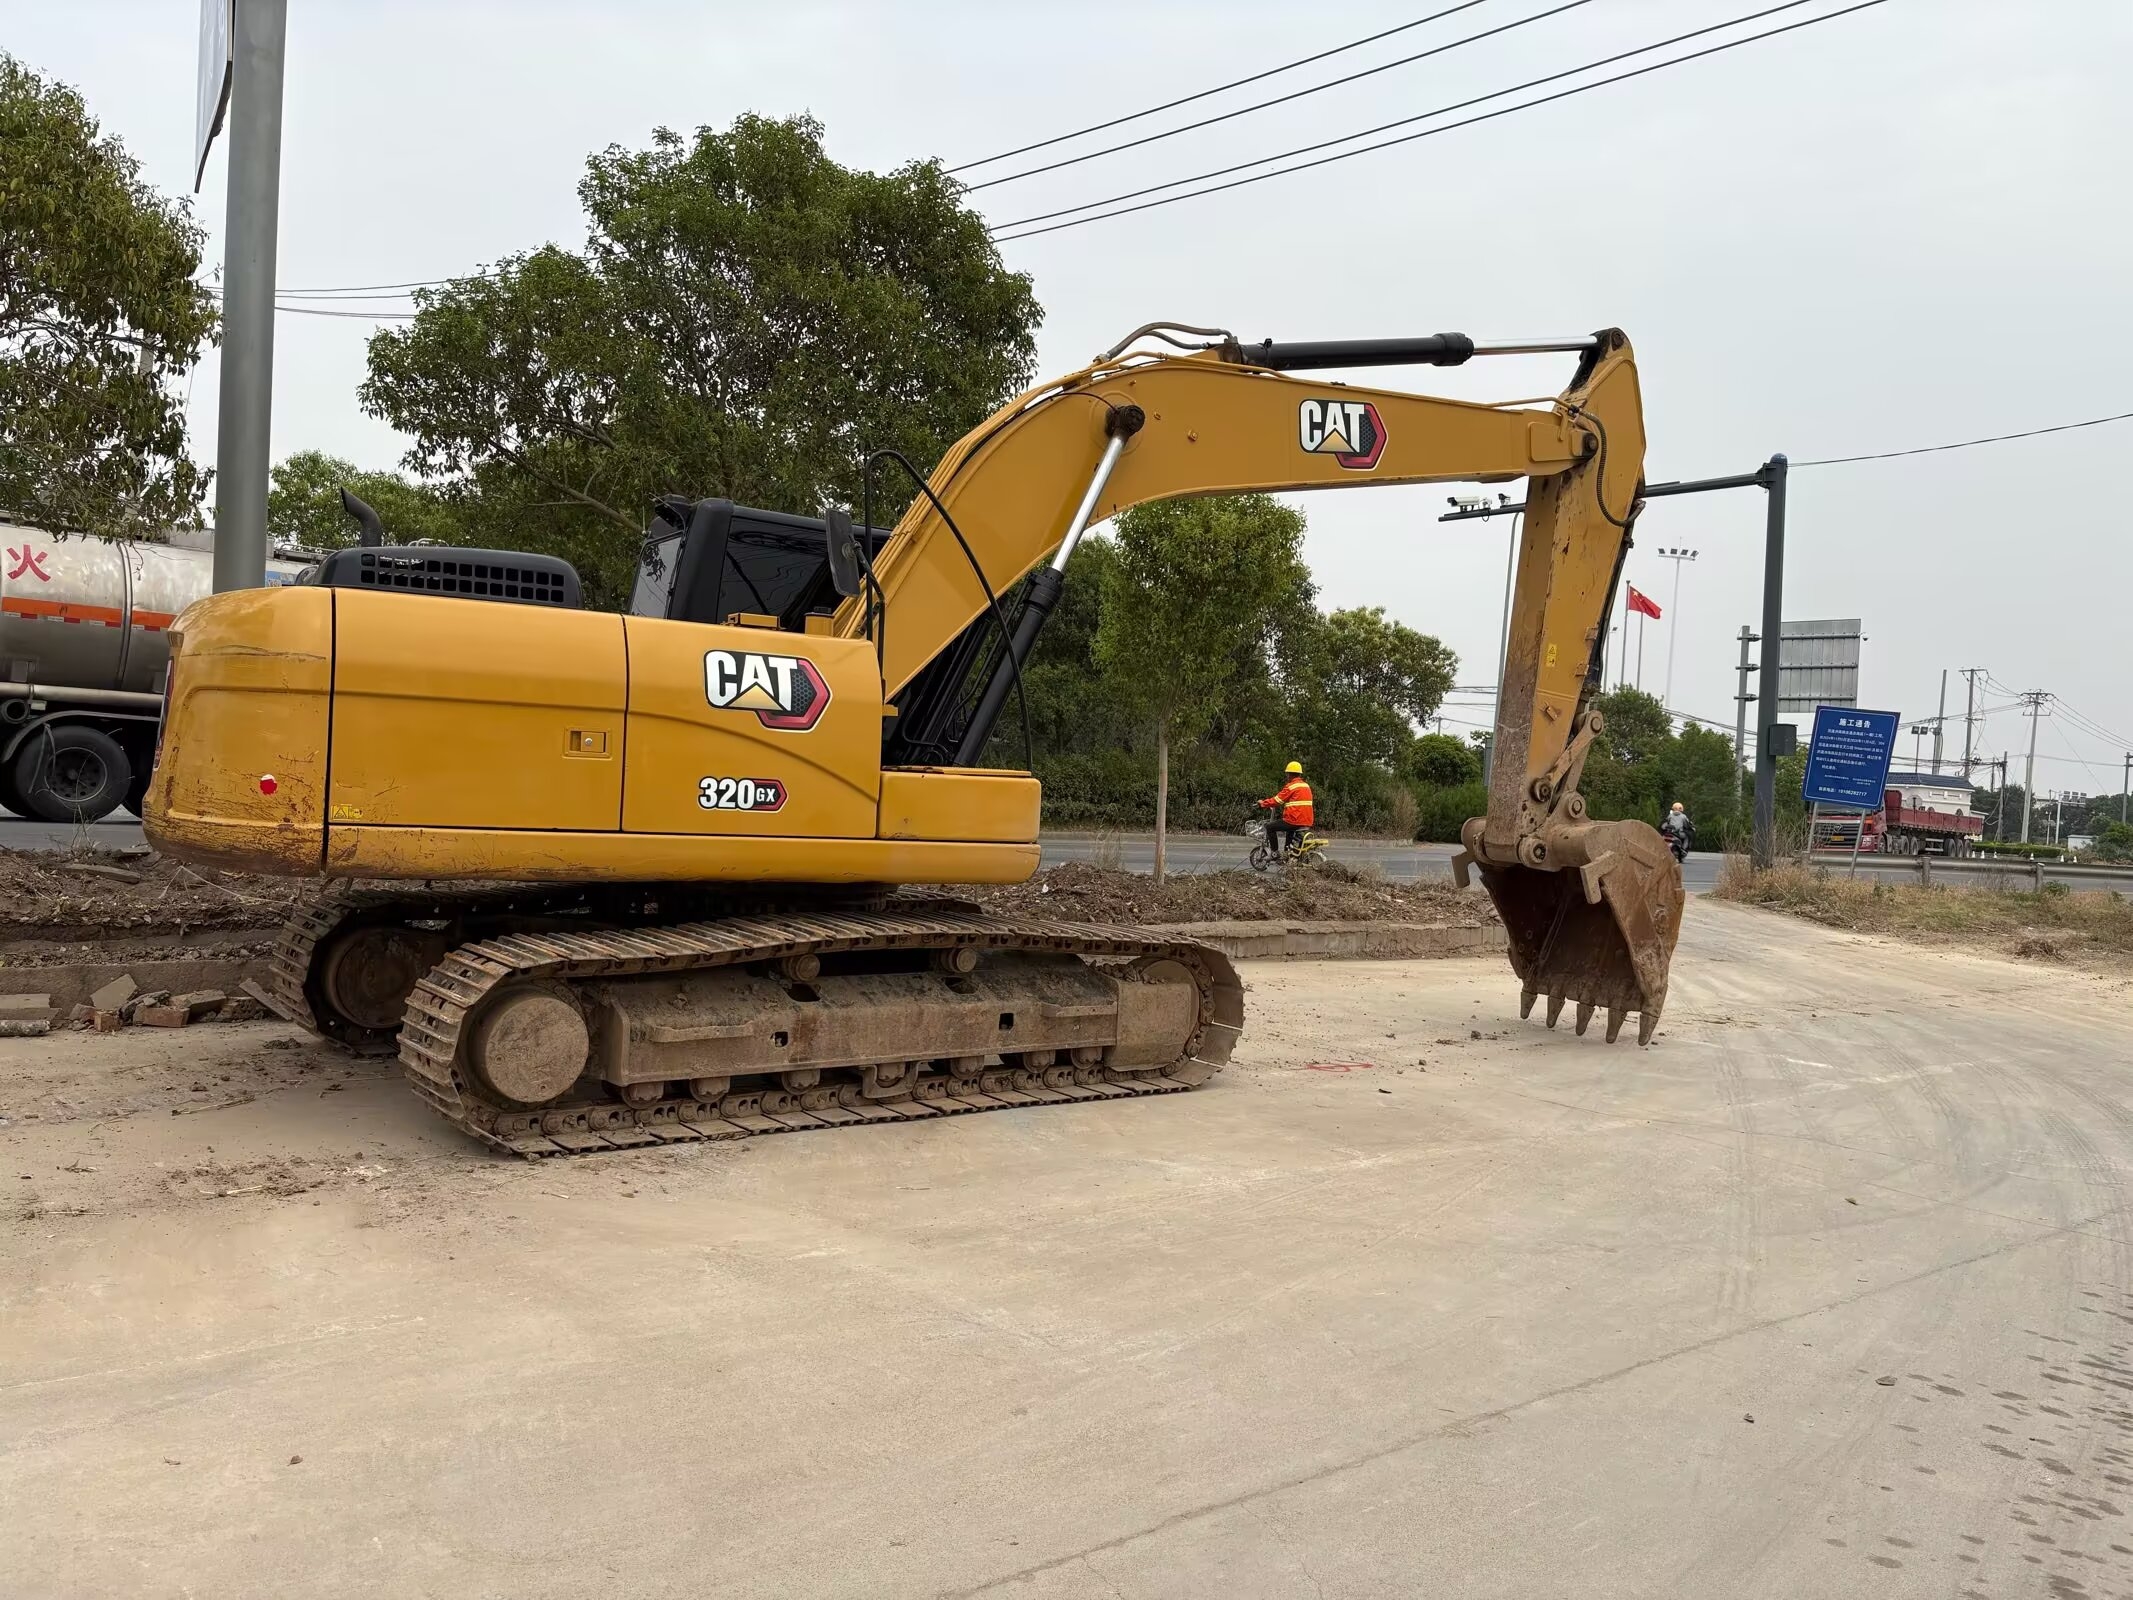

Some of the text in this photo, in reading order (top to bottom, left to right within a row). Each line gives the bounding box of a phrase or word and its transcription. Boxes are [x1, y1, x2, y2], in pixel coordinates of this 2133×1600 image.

[1300, 400, 1365, 453] CAT
[7, 544, 52, 582] 火
[705, 650, 798, 711] CAT
